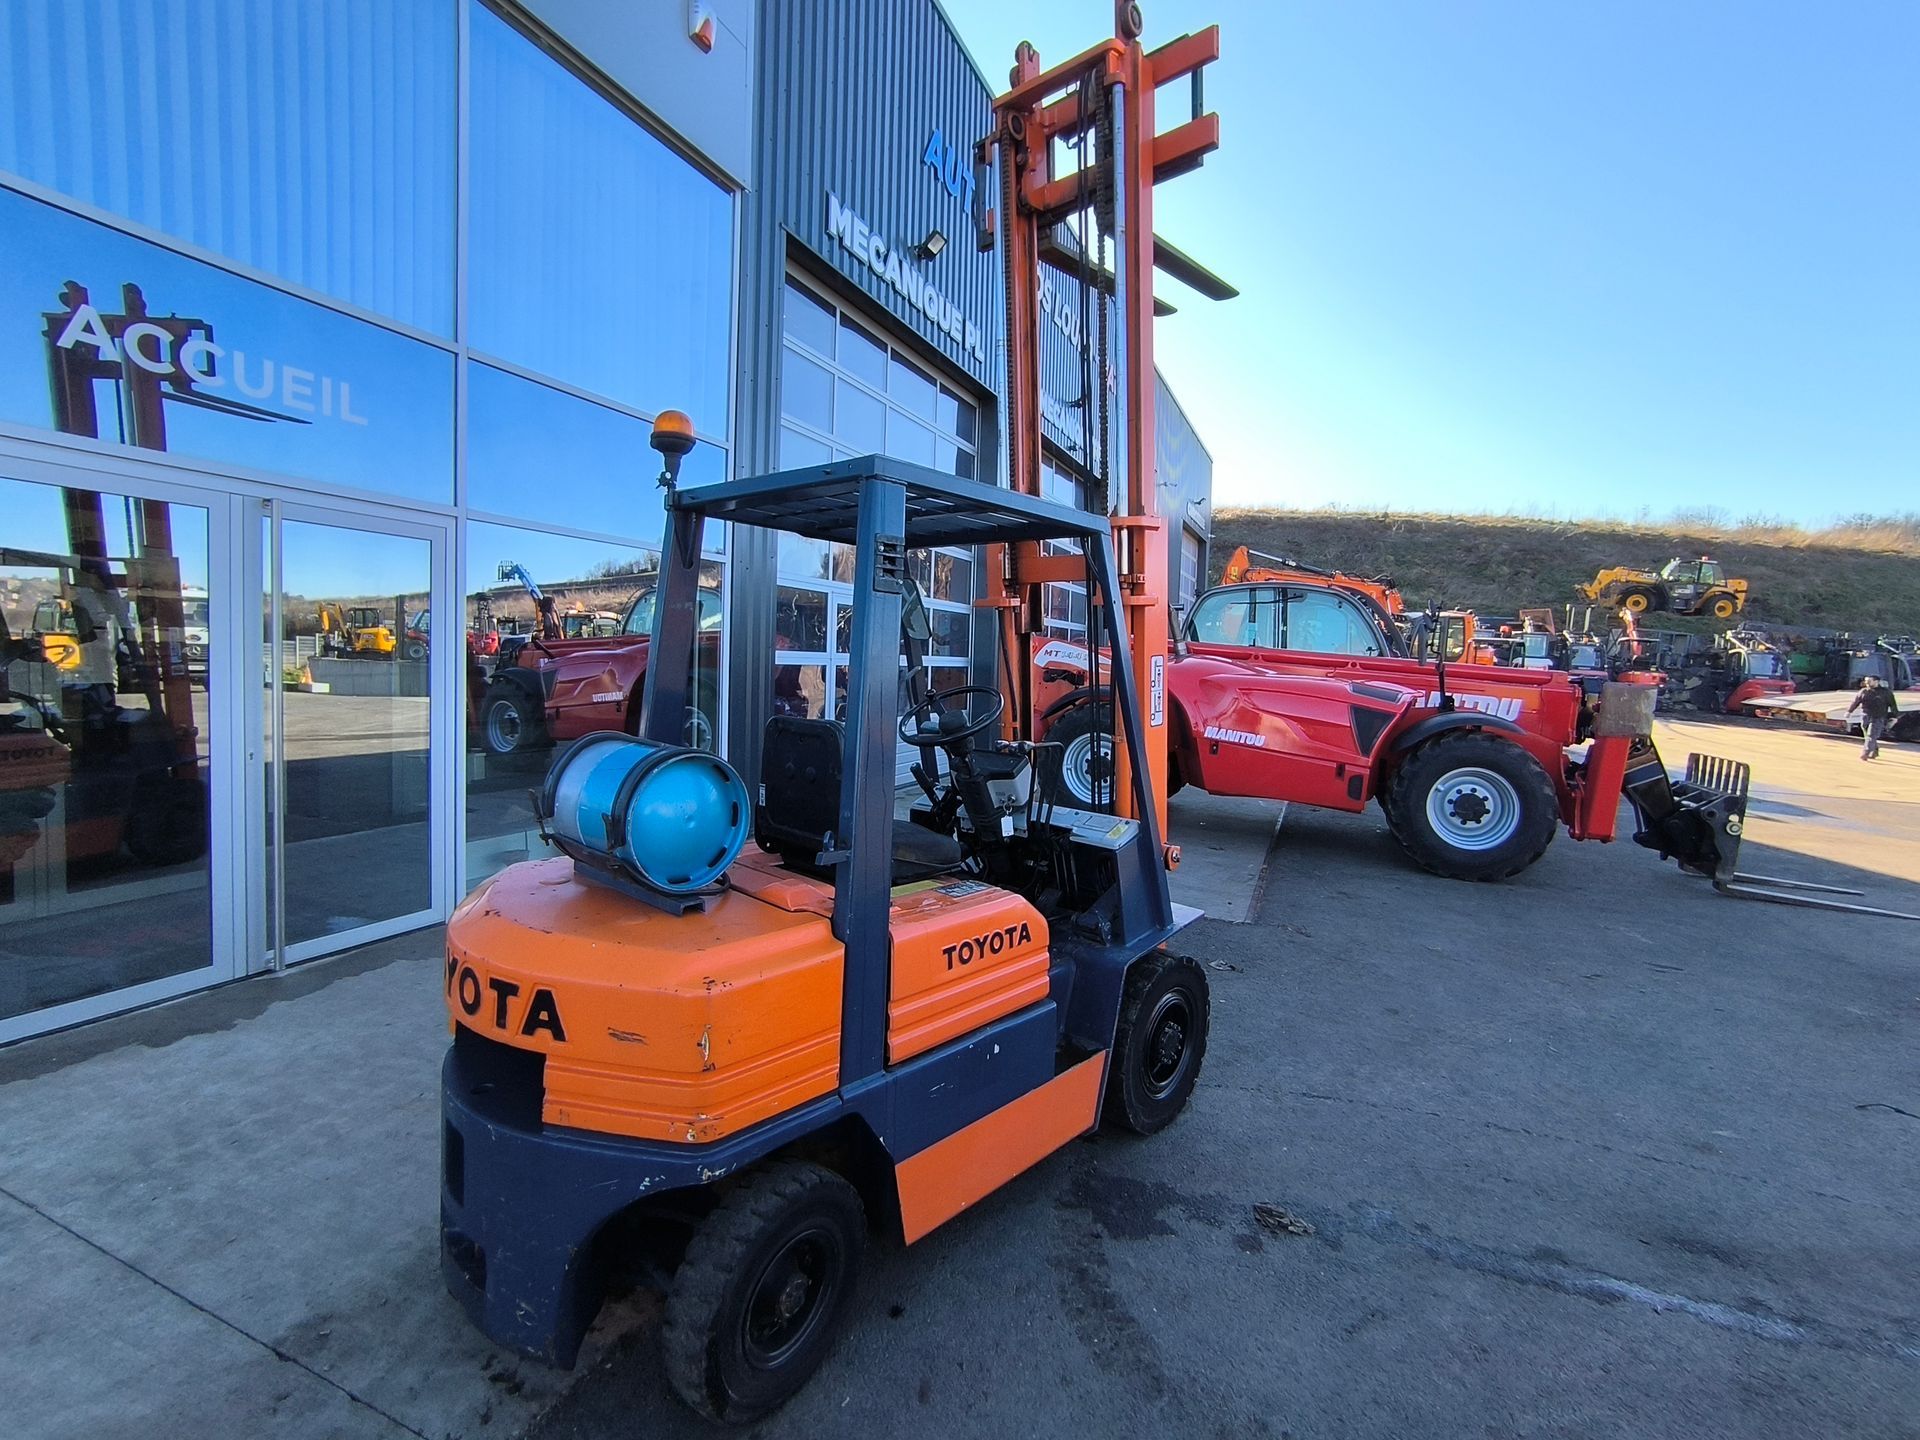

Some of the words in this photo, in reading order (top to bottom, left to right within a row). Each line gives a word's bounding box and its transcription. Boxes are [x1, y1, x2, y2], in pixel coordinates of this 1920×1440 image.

[827, 191, 963, 345] MECANIQUE
[965, 318, 985, 364] PL
[56, 303, 369, 426] ACCUEIL
[1204, 726, 1266, 746] MANITOU
[942, 922, 1032, 971] TOYOTA
